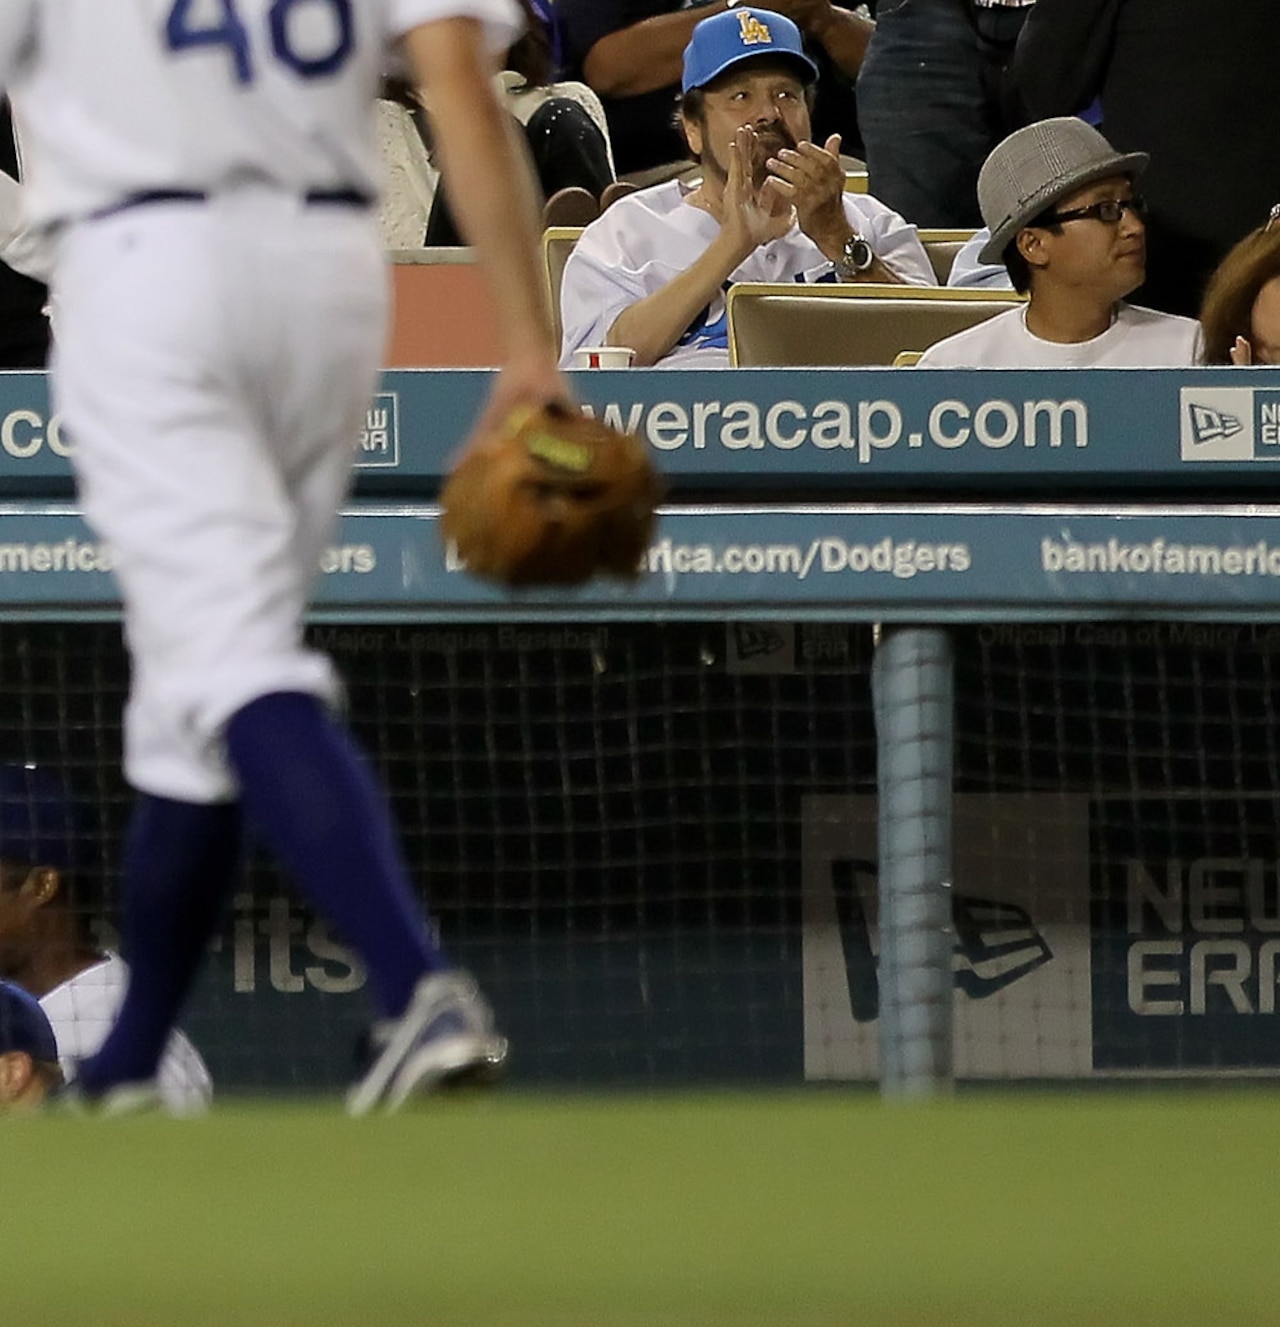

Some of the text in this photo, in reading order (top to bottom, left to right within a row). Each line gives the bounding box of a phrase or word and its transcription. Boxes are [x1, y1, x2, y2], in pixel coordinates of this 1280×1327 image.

[736, 11, 772, 45] LA
[581, 399, 1089, 463] weracap.com
[208, 892, 363, 993] its
